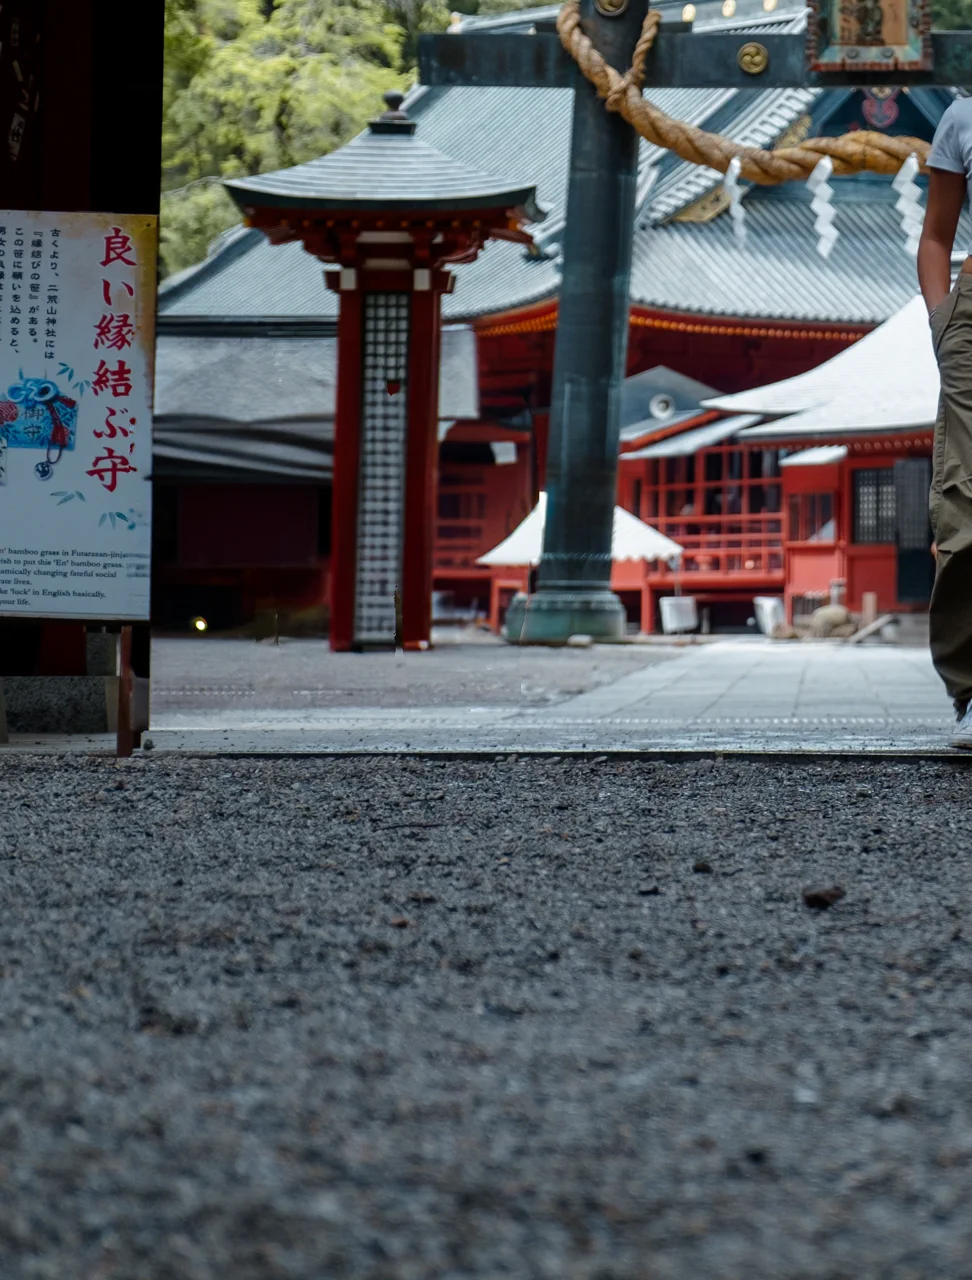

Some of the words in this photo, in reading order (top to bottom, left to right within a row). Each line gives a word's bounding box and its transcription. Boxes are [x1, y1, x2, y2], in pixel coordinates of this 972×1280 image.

[86, 226, 137, 493] 良い縁結ぶ守
[33, 569, 68, 578] changing
[42, 589, 71, 598] English
[72, 590, 106, 599] basically.
[17, 598, 31, 606] life.
